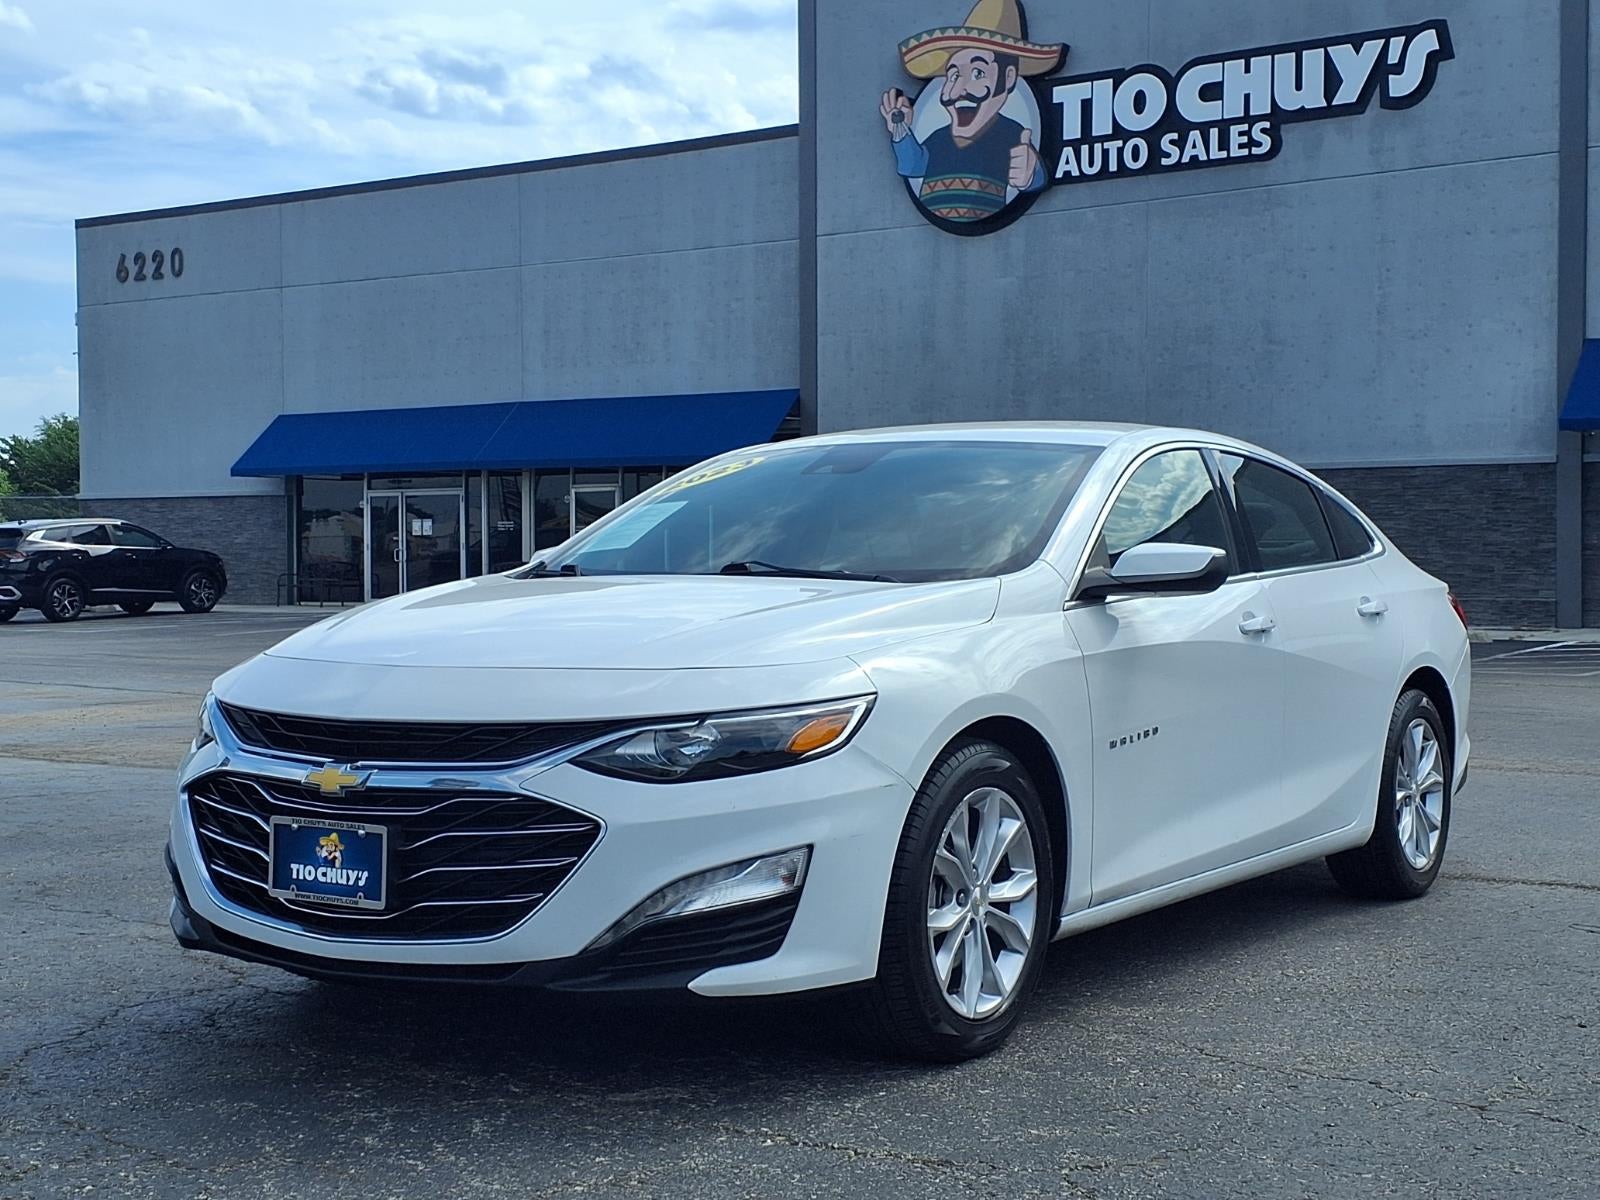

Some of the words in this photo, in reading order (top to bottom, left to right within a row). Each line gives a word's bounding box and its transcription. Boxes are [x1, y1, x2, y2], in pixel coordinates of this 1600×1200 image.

[1053, 73, 1167, 140] TIO
[1176, 28, 1440, 122] CHUY'S
[1055, 137, 1147, 179] AUTO
[1160, 121, 1271, 166] SALES
[116, 247, 183, 283] 6220
[327, 821, 344, 829] AUTO
